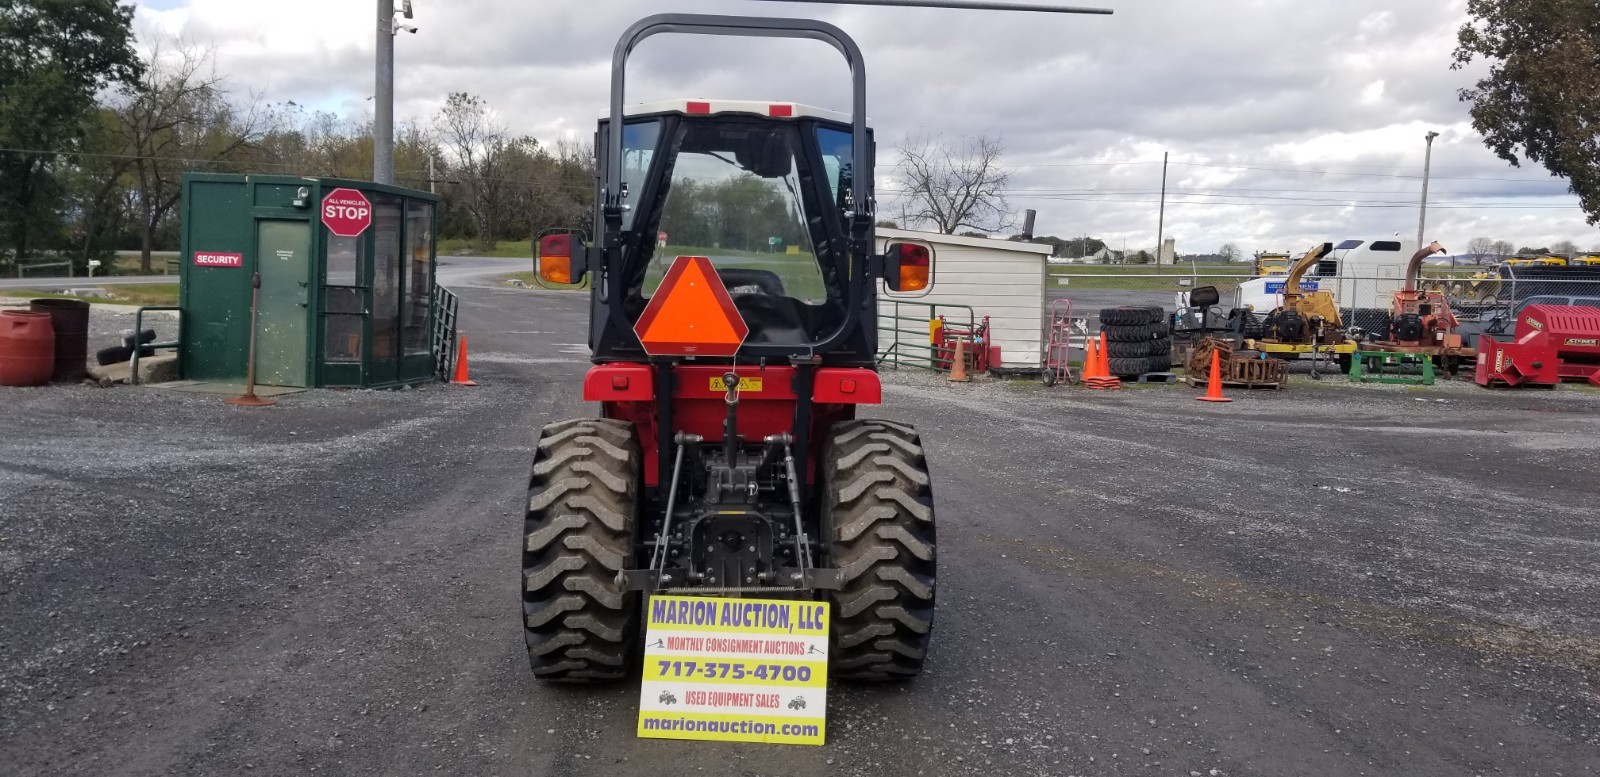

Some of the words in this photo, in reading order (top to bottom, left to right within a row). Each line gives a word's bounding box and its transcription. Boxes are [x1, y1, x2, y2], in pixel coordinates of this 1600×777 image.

[325, 205, 368, 220] STOP
[197, 255, 239, 264] SECURITY
[652, 600, 717, 626] MARION
[720, 602, 794, 634] AUCTION,
[798, 605, 824, 630] LLC
[667, 636, 704, 651] MONTHLY
[705, 638, 764, 654] CONSIGNMENT
[764, 641, 805, 655] AUCTIONS
[658, 661, 811, 682] 717-375-4700
[685, 690, 707, 706] USED
[707, 691, 754, 708] EQUIPMENT
[755, 694, 780, 709] SALES
[643, 717, 818, 737] marionauction.com
